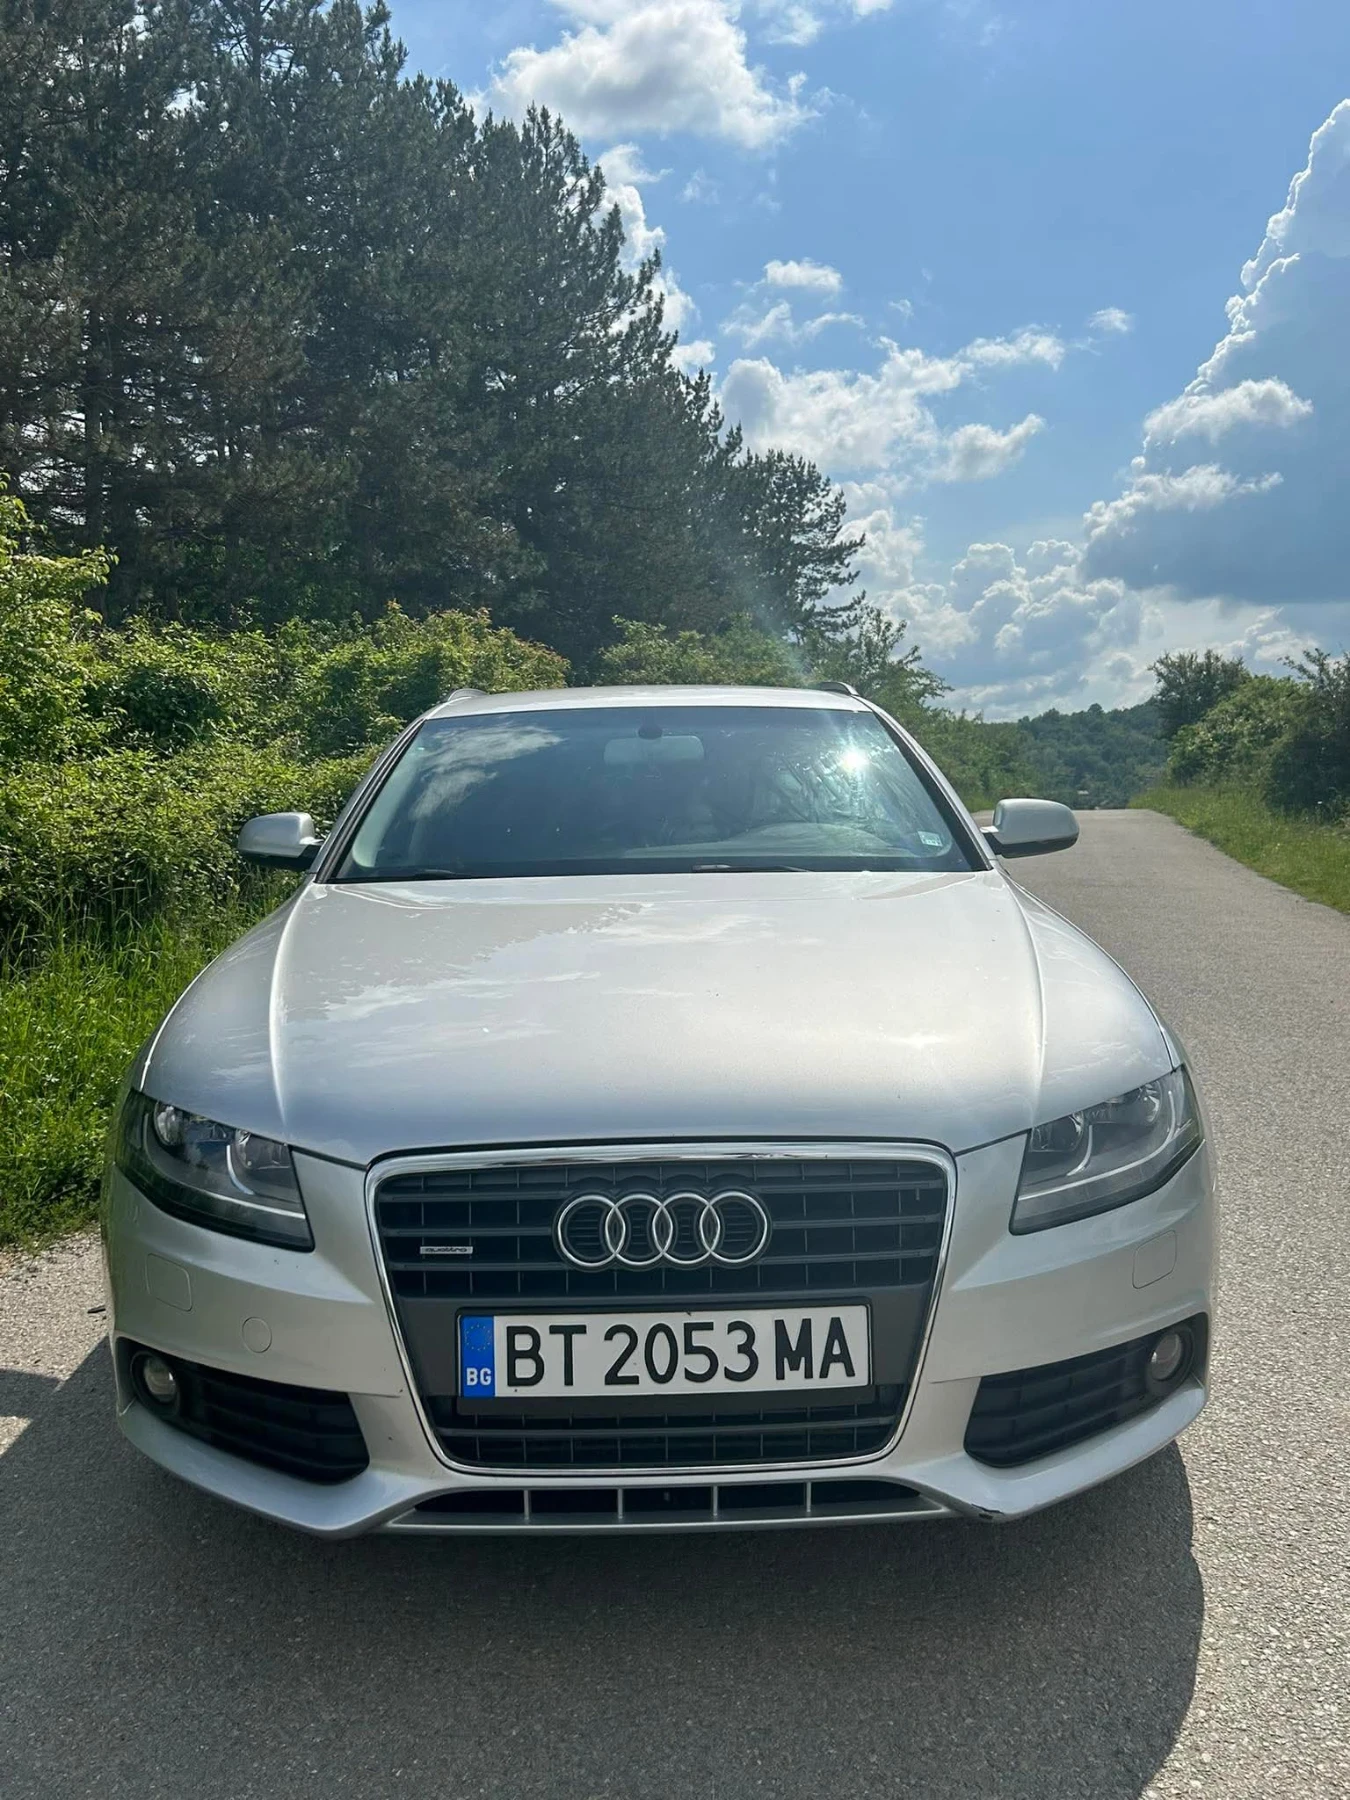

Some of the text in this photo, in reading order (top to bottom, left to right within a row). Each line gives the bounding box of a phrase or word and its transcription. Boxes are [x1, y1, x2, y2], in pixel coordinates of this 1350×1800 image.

[506, 1316, 856, 1387] BT 2053 MA
[466, 1367, 492, 1386] BG
